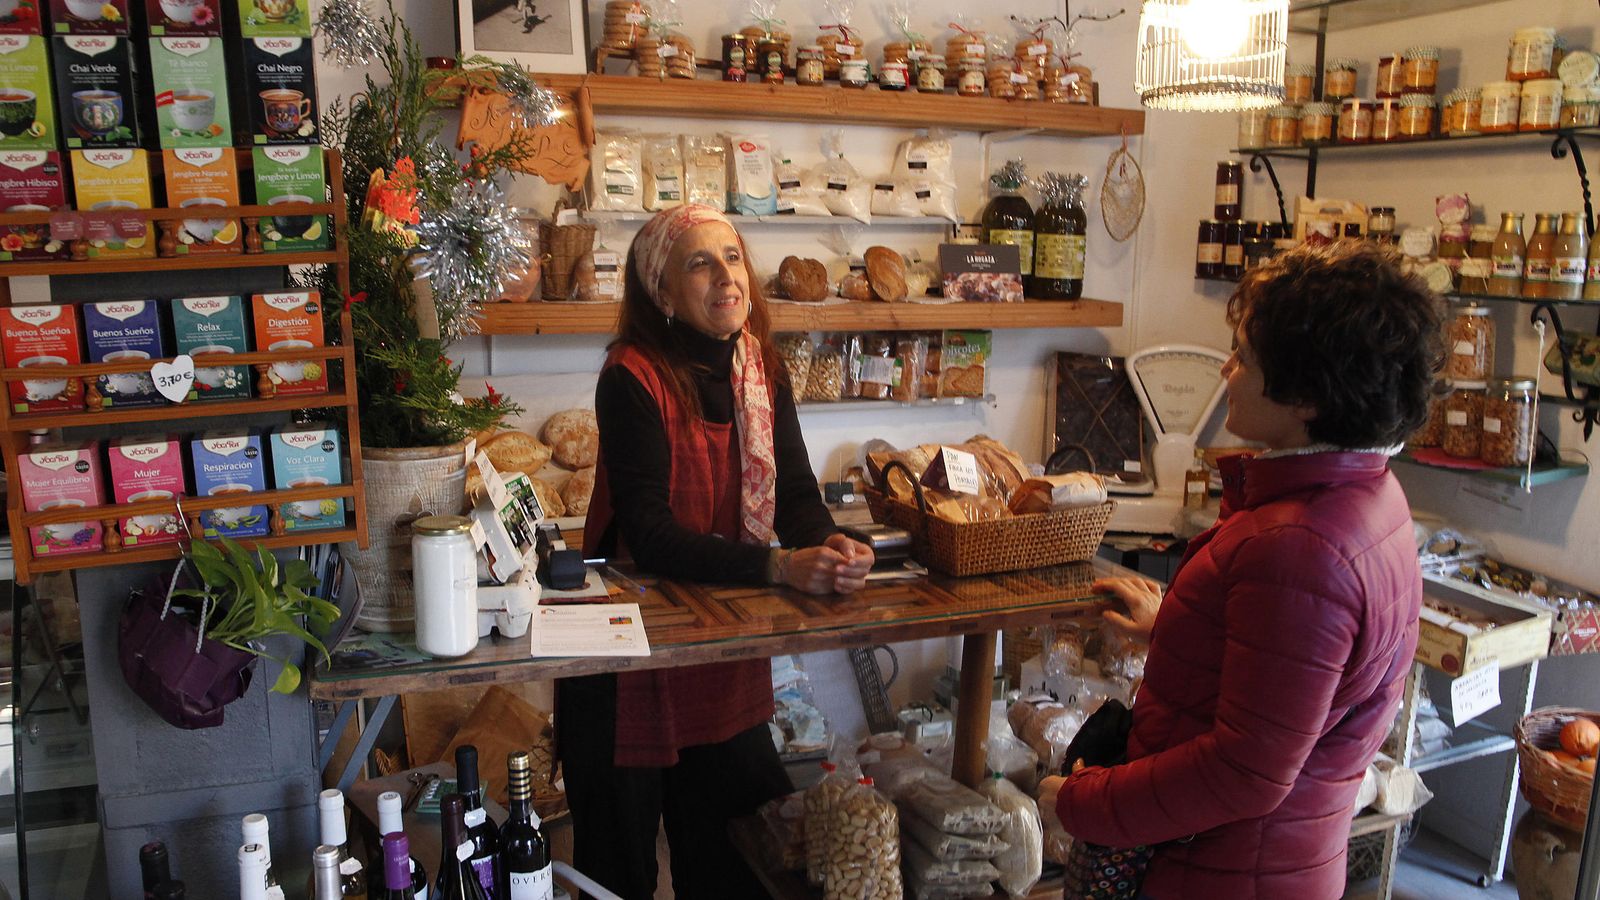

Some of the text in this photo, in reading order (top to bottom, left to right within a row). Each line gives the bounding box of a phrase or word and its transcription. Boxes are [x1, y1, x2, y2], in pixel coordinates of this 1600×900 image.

[69, 63, 117, 73] Chai Verde
[257, 63, 303, 74] Chai Negro
[173, 169, 200, 179] Jengibre
[257, 173, 290, 183] Jengibre
[296, 171, 321, 180] Limón
[26, 178, 59, 187] Hibisco
[197, 322, 221, 331] Relax
[268, 317, 309, 328] Digestión
[6, 326, 71, 338] Buenos Sueños
[93, 326, 154, 338] Buenos Sueños
[286, 455, 325, 465] Voz Clara
[203, 461, 253, 473] Respiración
[134, 468, 161, 479] Mujer
[26, 475, 91, 489] Mujer Equilibrio
